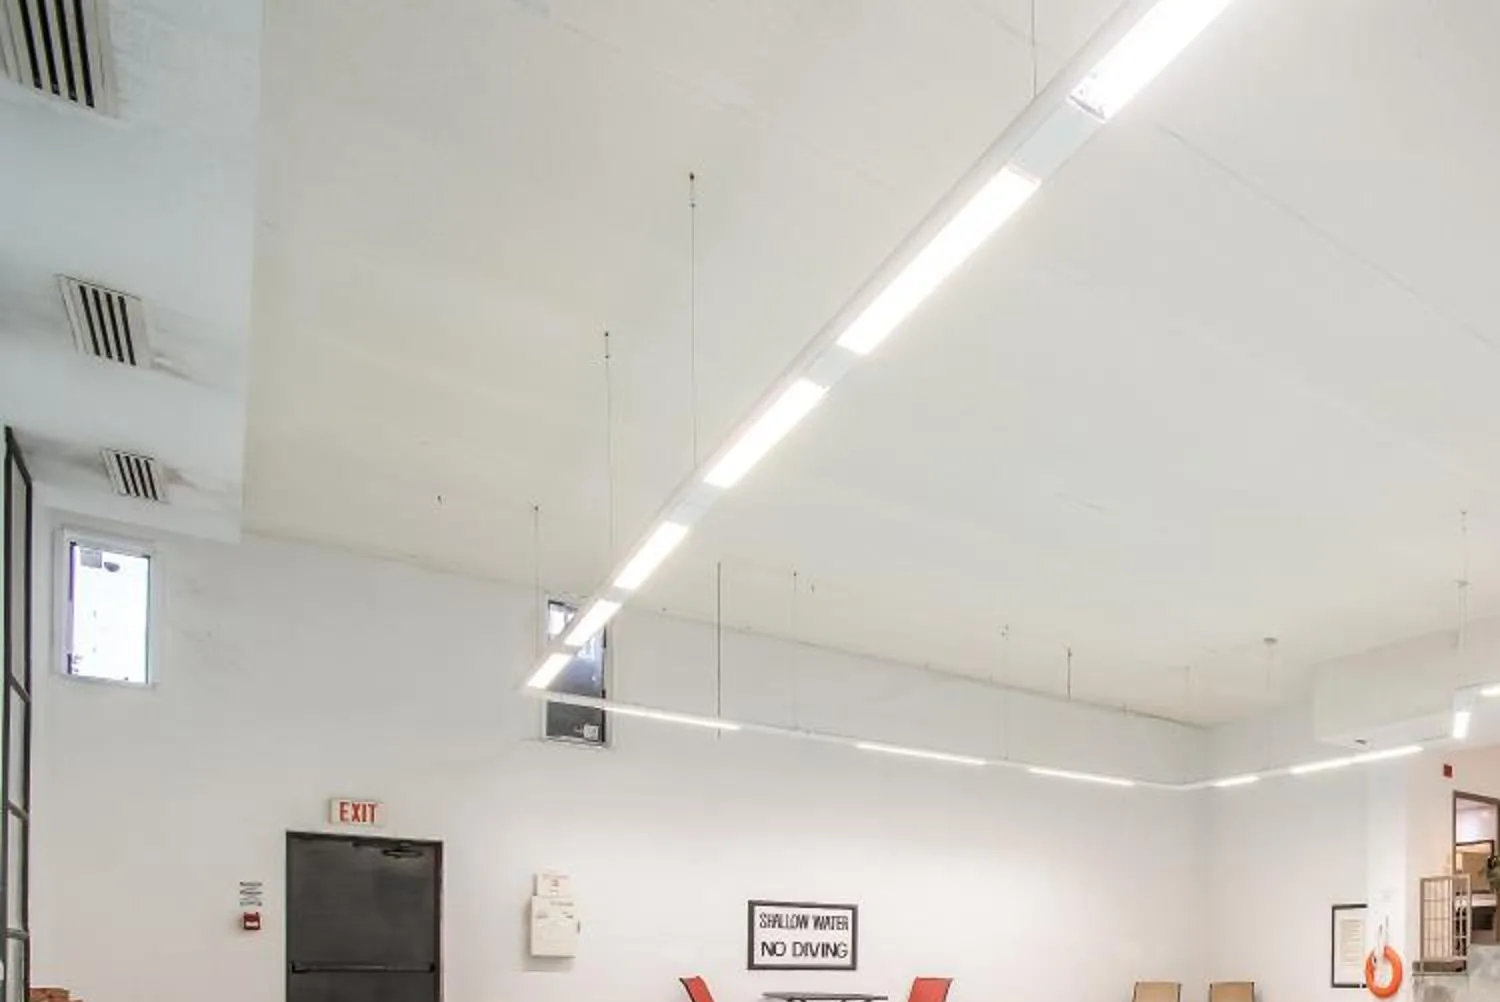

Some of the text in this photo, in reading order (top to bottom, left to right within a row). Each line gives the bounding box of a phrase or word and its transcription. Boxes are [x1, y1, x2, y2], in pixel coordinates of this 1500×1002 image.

[339, 801, 377, 823] EXIT
[760, 912, 848, 930] SHALLOW WATER
[761, 941, 848, 959] NO DIVING
